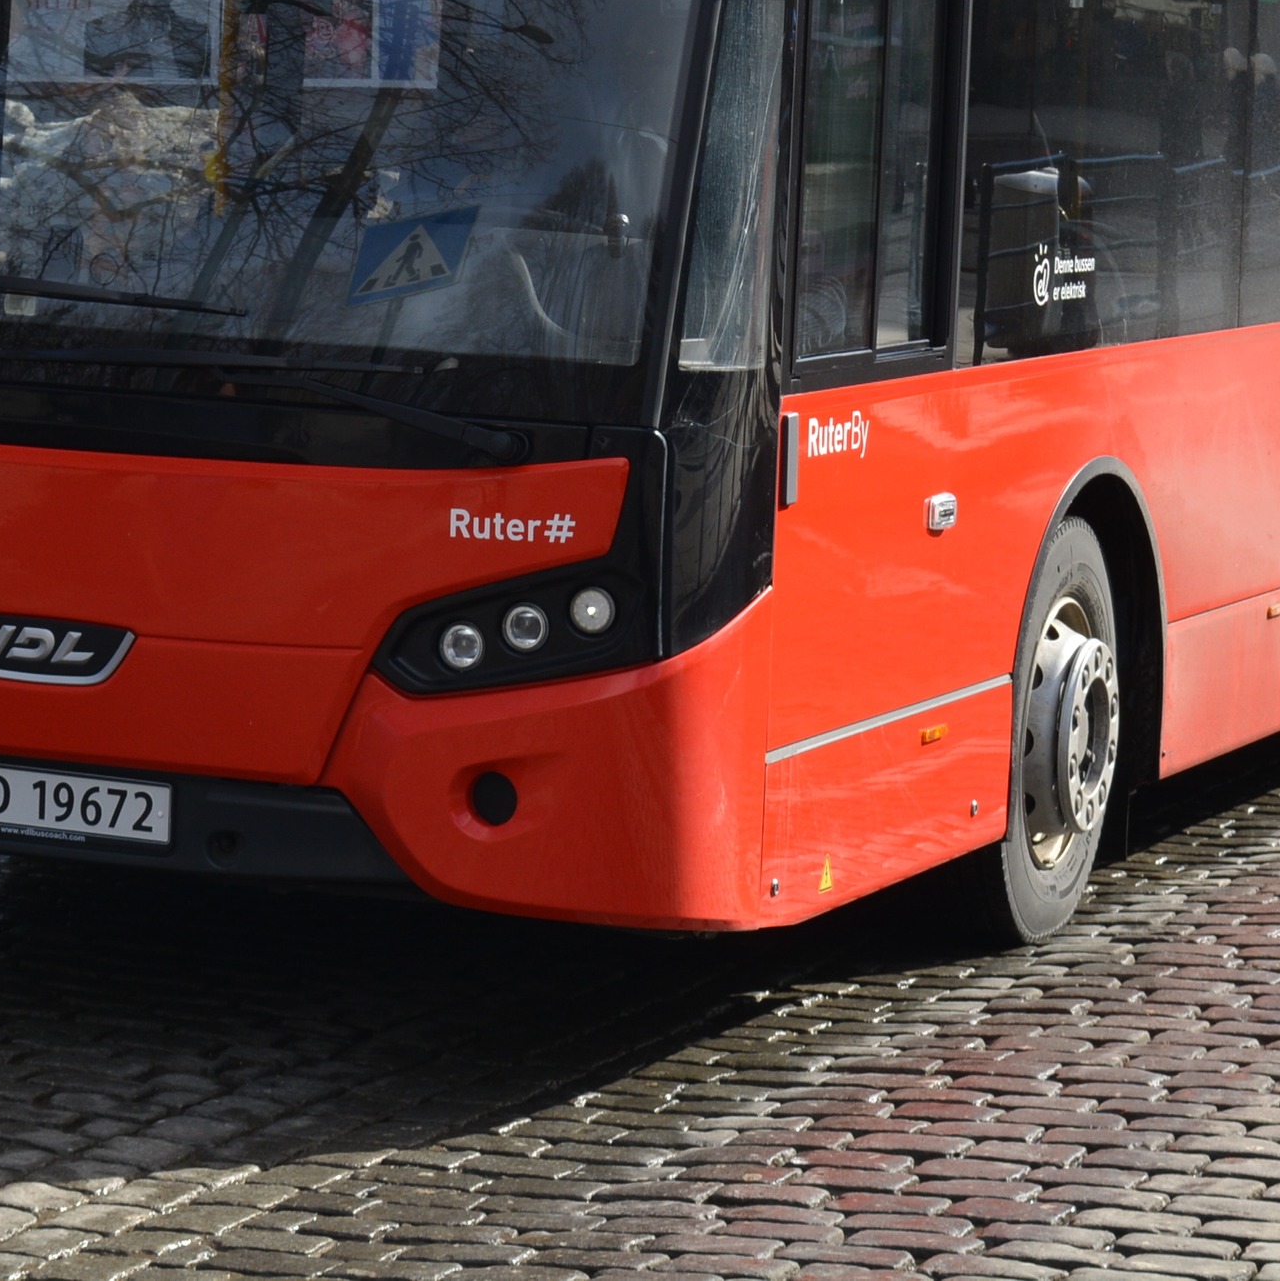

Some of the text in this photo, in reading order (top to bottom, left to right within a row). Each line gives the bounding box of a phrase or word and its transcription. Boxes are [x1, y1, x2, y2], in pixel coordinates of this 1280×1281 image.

[1054, 254, 1095, 274] Denne bussen
[1053, 280, 1087, 301] er elektrisk
[807, 410, 870, 459] RuterBy
[32, 780, 154, 833] 19672
[0, 825, 86, 843] www.vdlbuscoach.com
